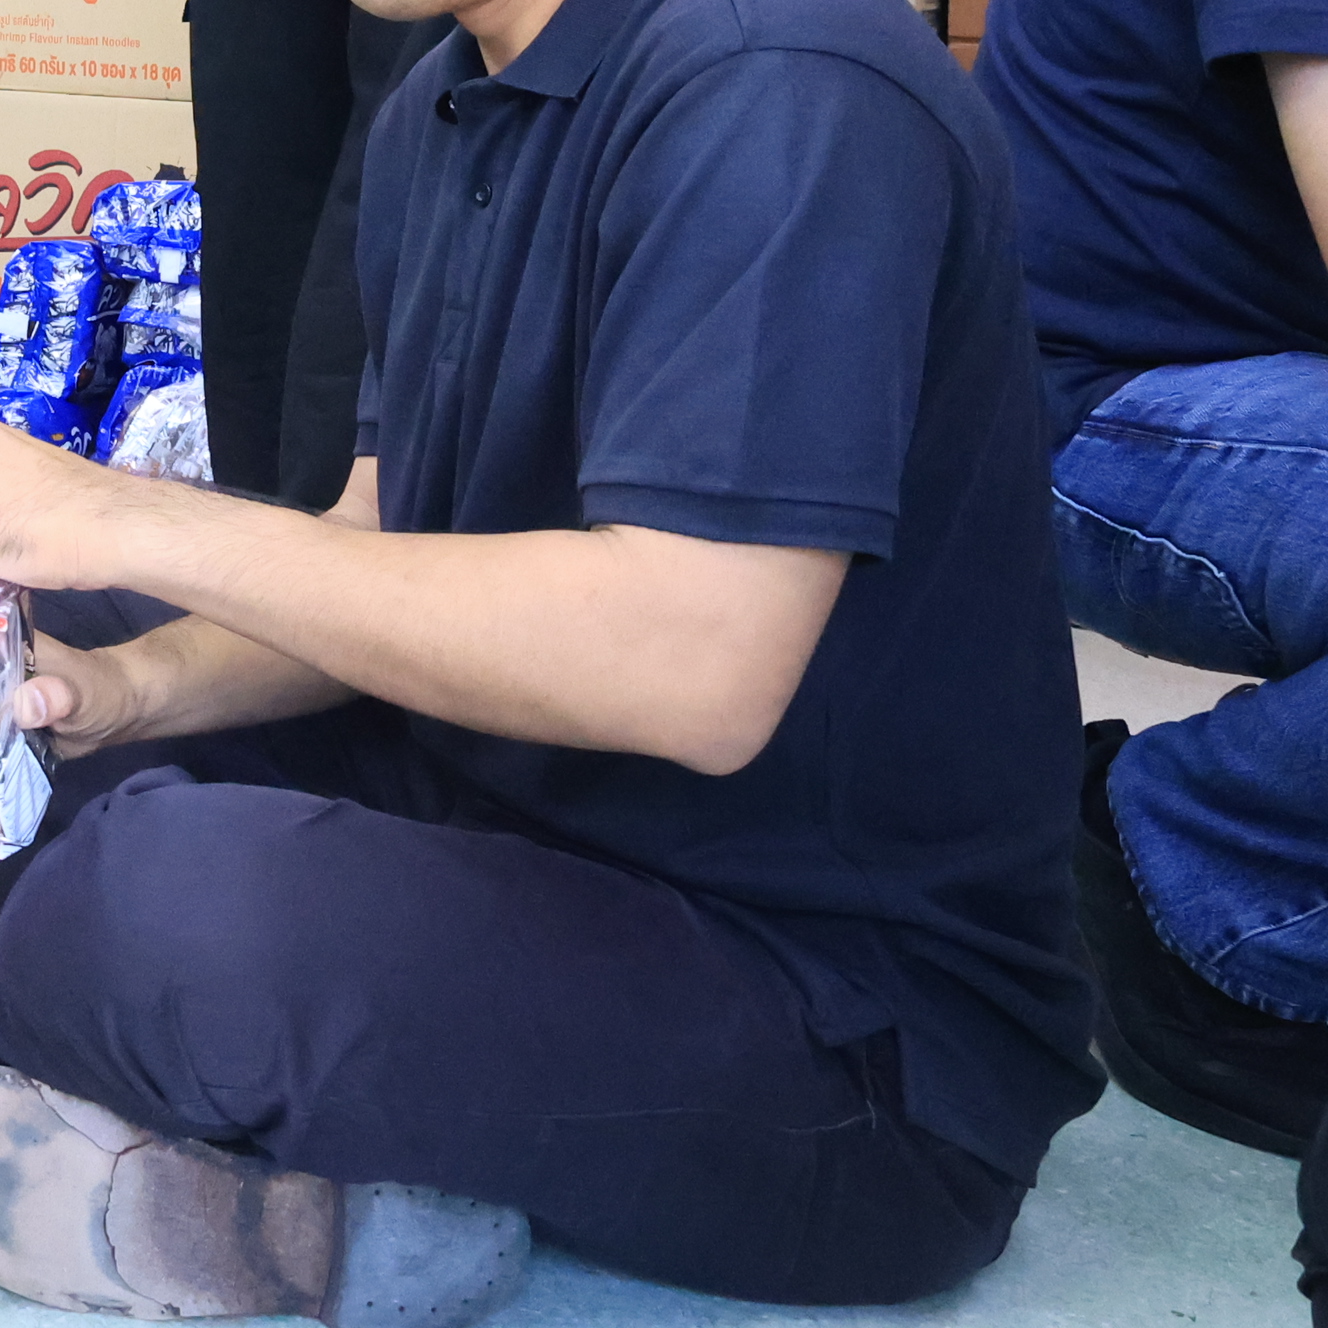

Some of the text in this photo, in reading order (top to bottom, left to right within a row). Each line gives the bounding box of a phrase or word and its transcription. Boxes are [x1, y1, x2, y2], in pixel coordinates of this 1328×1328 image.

[29, 32, 63, 45] Flavour
[66, 35, 99, 47] Instant
[101, 36, 141, 48] Noodles
[19, 57, 36, 73] 60
[39, 55, 66, 75] กรัม
[69, 63, 76, 76] x
[80, 60, 97, 77] 10
[100, 63, 126, 79] ซอง
[129, 66, 137, 80] x
[141, 63, 159, 81] 18
[162, 66, 182, 89] ชุด
